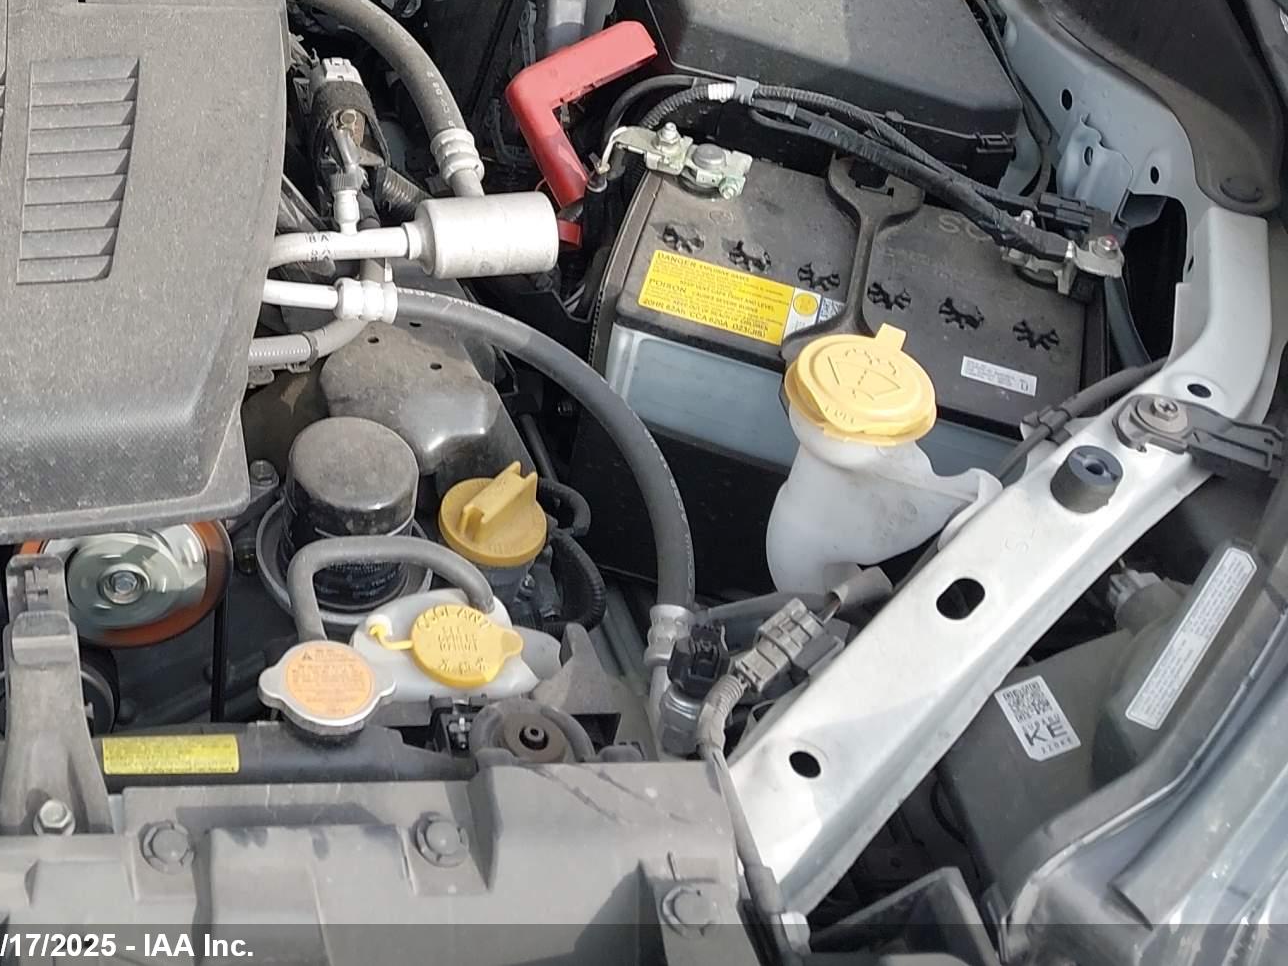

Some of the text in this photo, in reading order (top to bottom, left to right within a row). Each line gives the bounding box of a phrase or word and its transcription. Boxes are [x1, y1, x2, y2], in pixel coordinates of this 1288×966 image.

[656, 252, 696, 265] DANGER
[648, 278, 687, 293] POISON
[1024, 721, 1068, 746] KE
